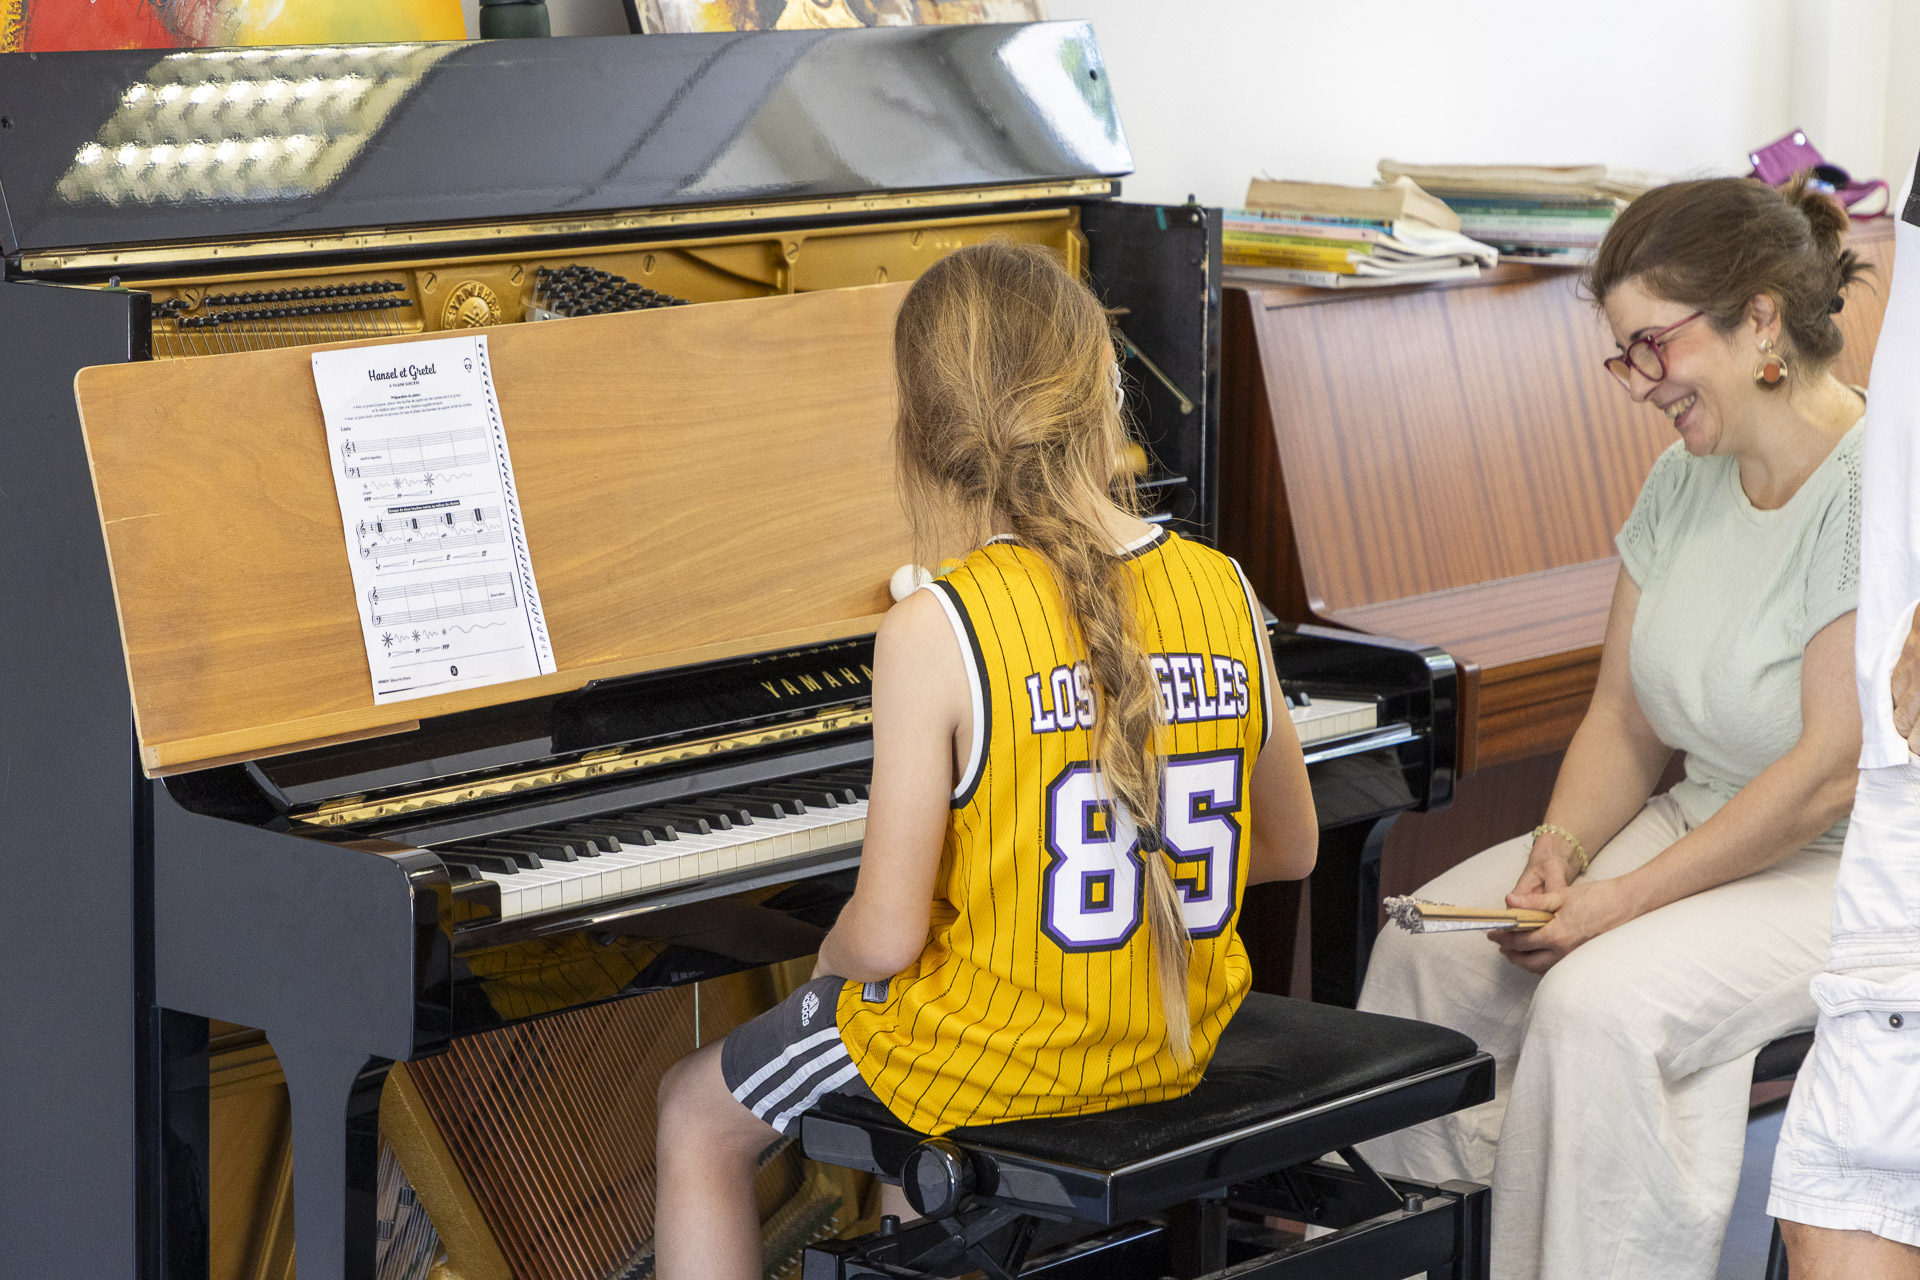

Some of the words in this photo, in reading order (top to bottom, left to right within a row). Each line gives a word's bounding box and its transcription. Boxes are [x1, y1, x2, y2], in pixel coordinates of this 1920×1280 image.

[368, 367, 398, 382] Hansel
[400, 367, 407, 378] et
[408, 363, 437, 381] Gretel
[760, 664, 873, 698] YAMAHA
[1025, 660, 1095, 734] LOS
[1149, 652, 1250, 725] GELES
[1040, 748, 1244, 953] 85
[801, 991, 812, 1027] adidas
